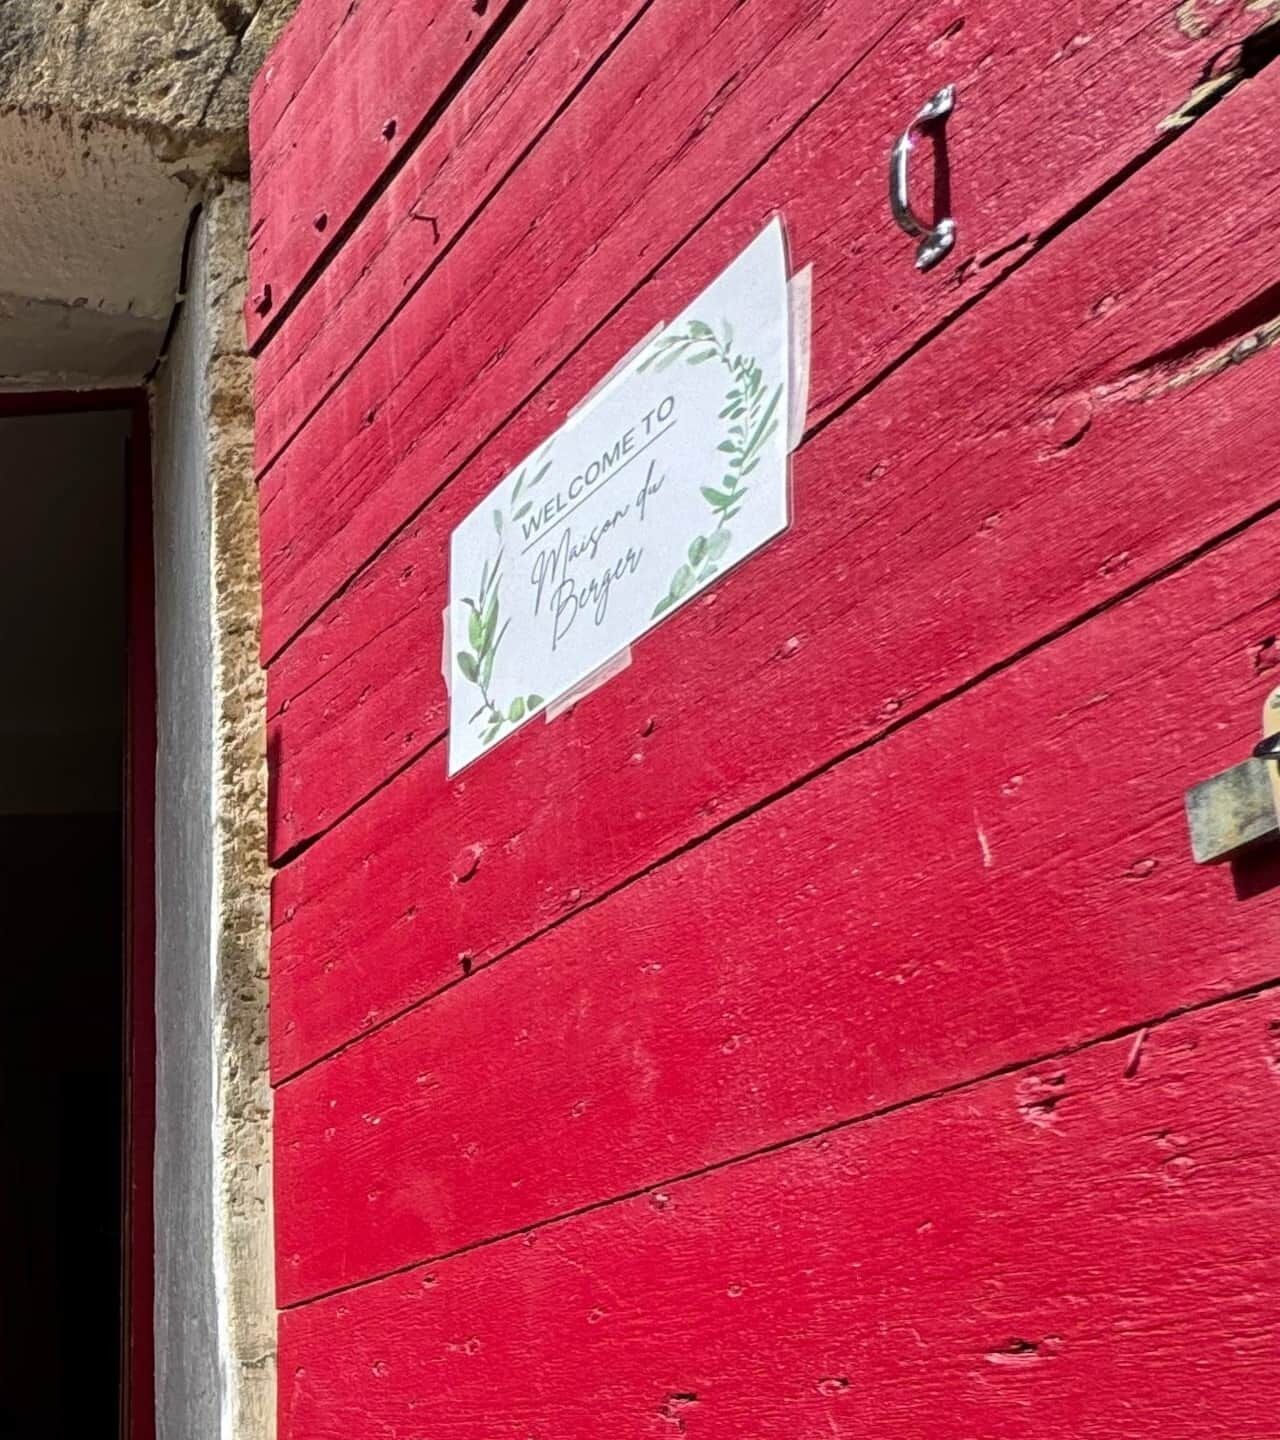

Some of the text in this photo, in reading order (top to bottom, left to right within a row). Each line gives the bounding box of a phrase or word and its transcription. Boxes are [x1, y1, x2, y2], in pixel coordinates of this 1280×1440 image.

[522, 396, 674, 540] WELCOME TO
[531, 459, 666, 616] Maison du
[550, 548, 643, 651] Berger
